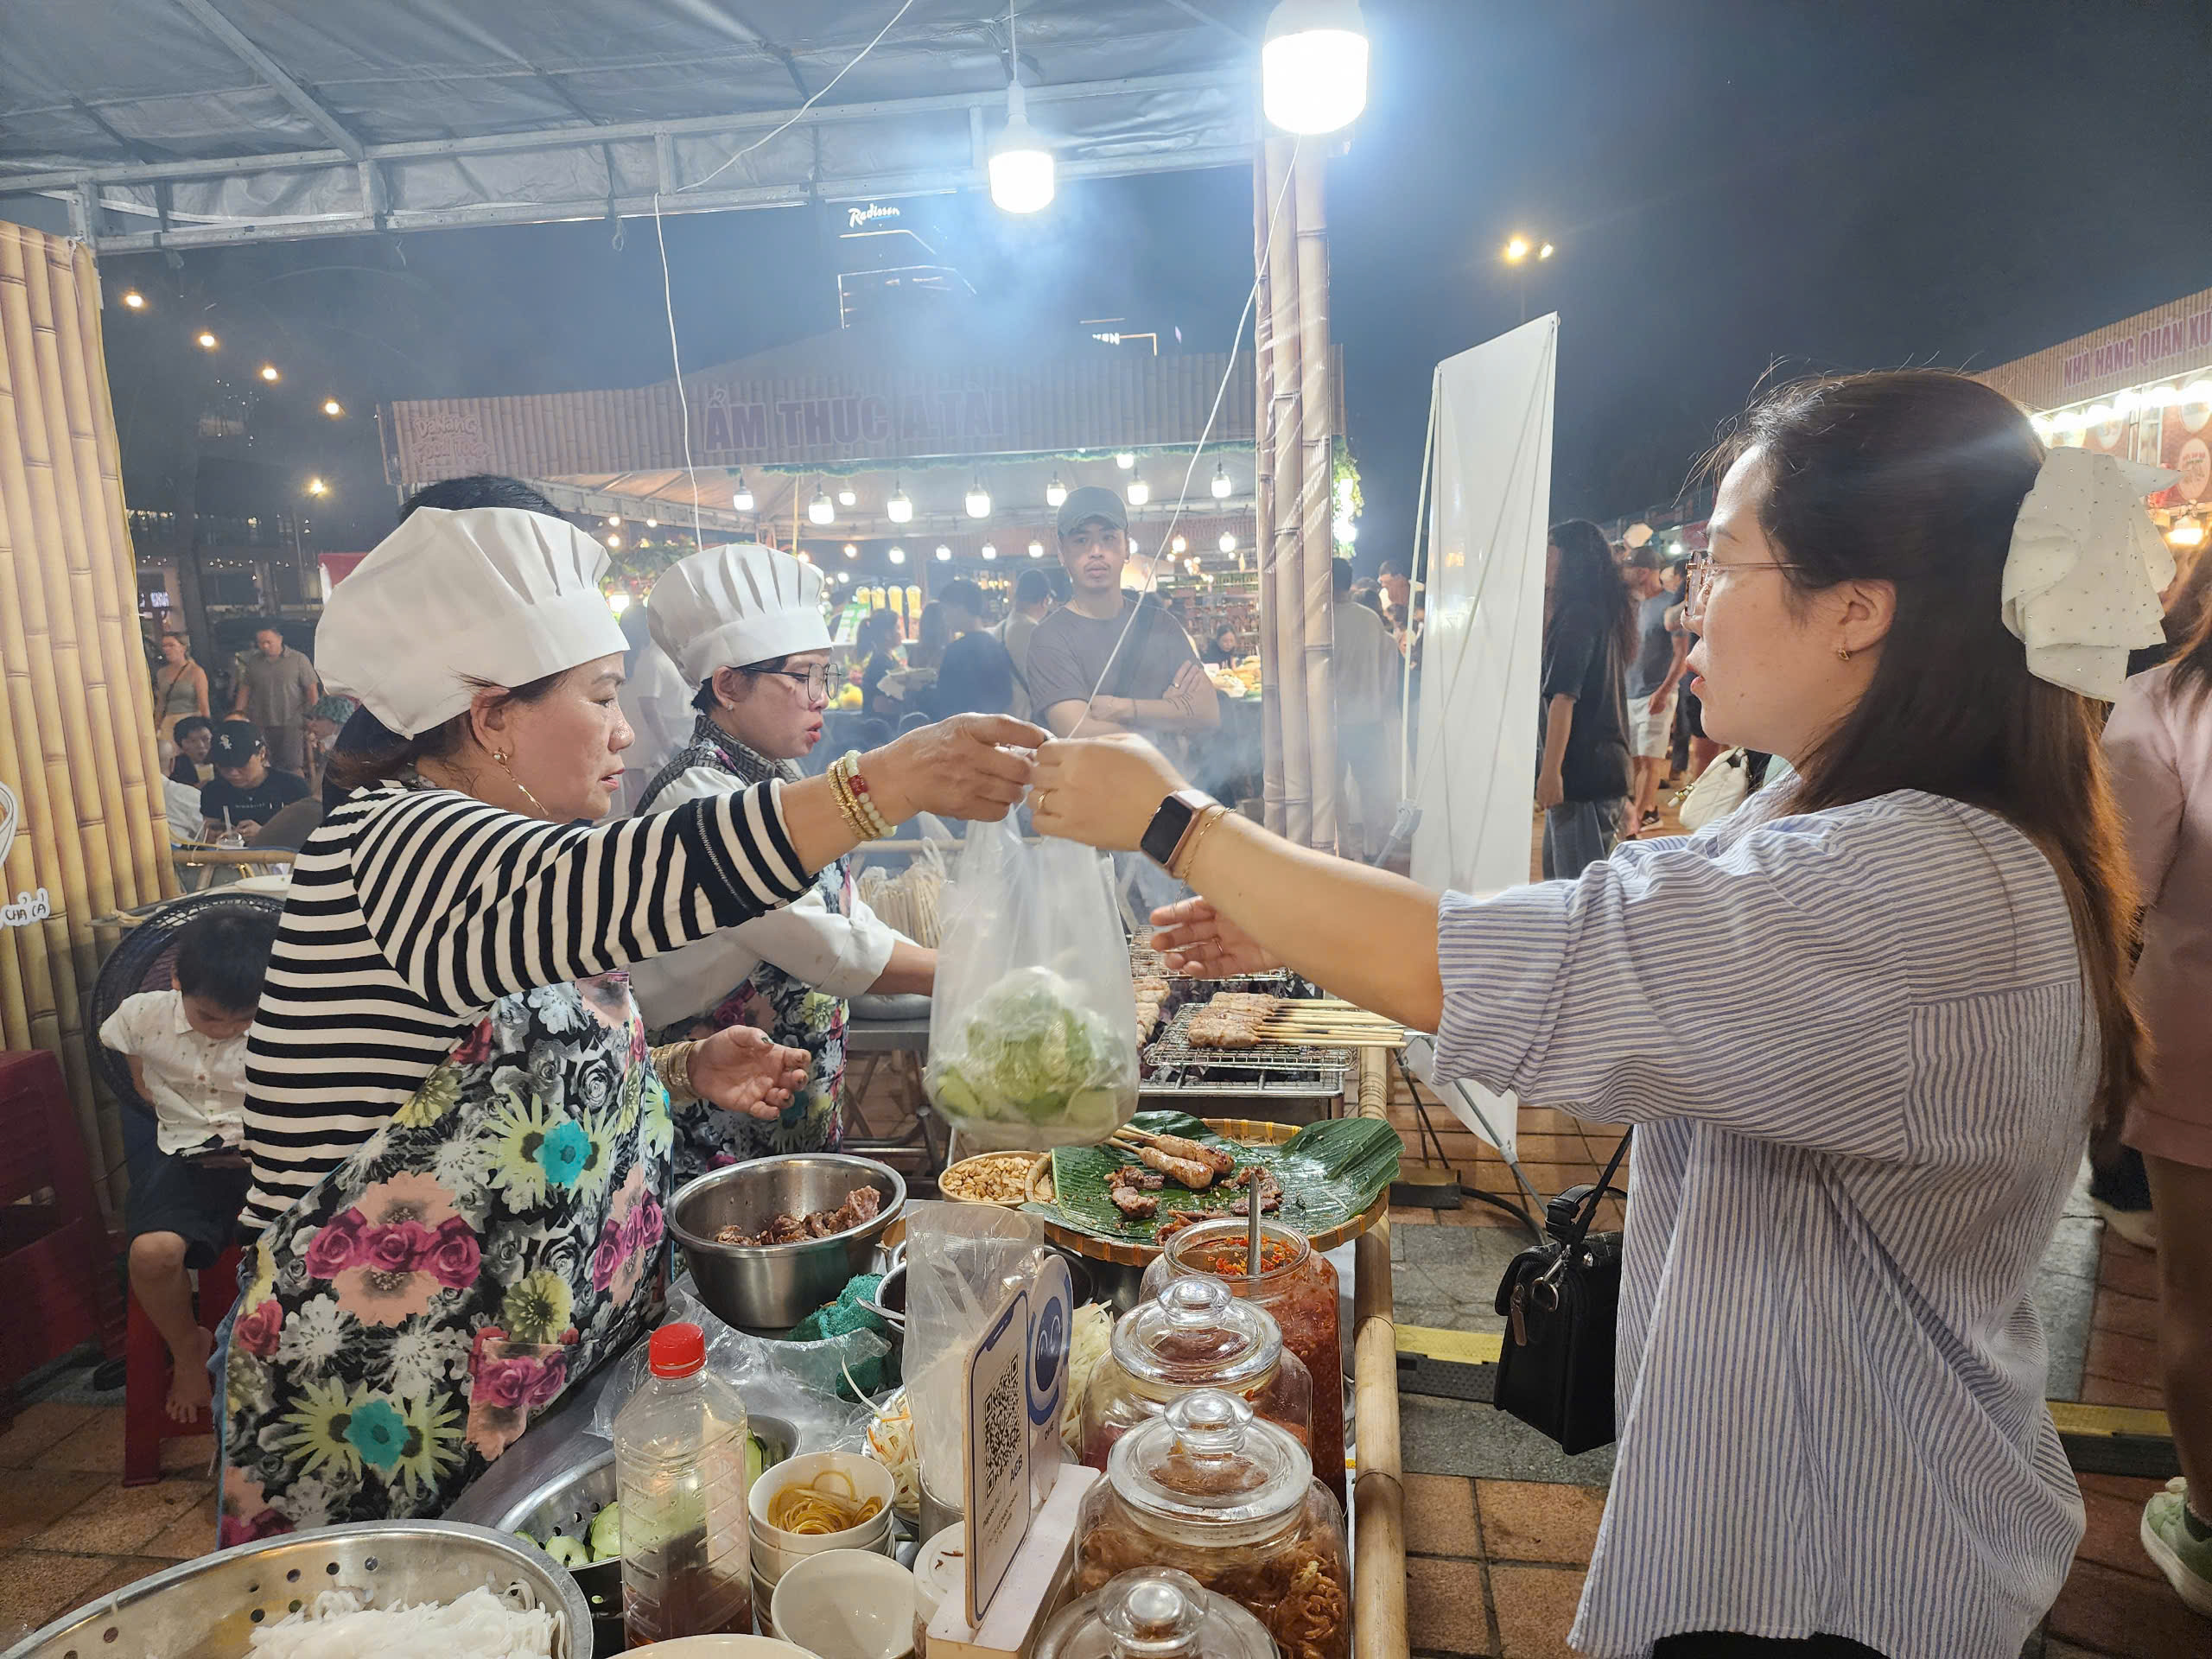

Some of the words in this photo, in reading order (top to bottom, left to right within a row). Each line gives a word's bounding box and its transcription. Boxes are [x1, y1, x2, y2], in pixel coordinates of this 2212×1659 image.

[848, 203, 900, 228] Radisson
[2063, 347, 2090, 387] NHÀ
[2094, 337, 2134, 378] HÀNG
[776, 389, 892, 455] THỰC
[1009, 1453, 1023, 1486] ACB
